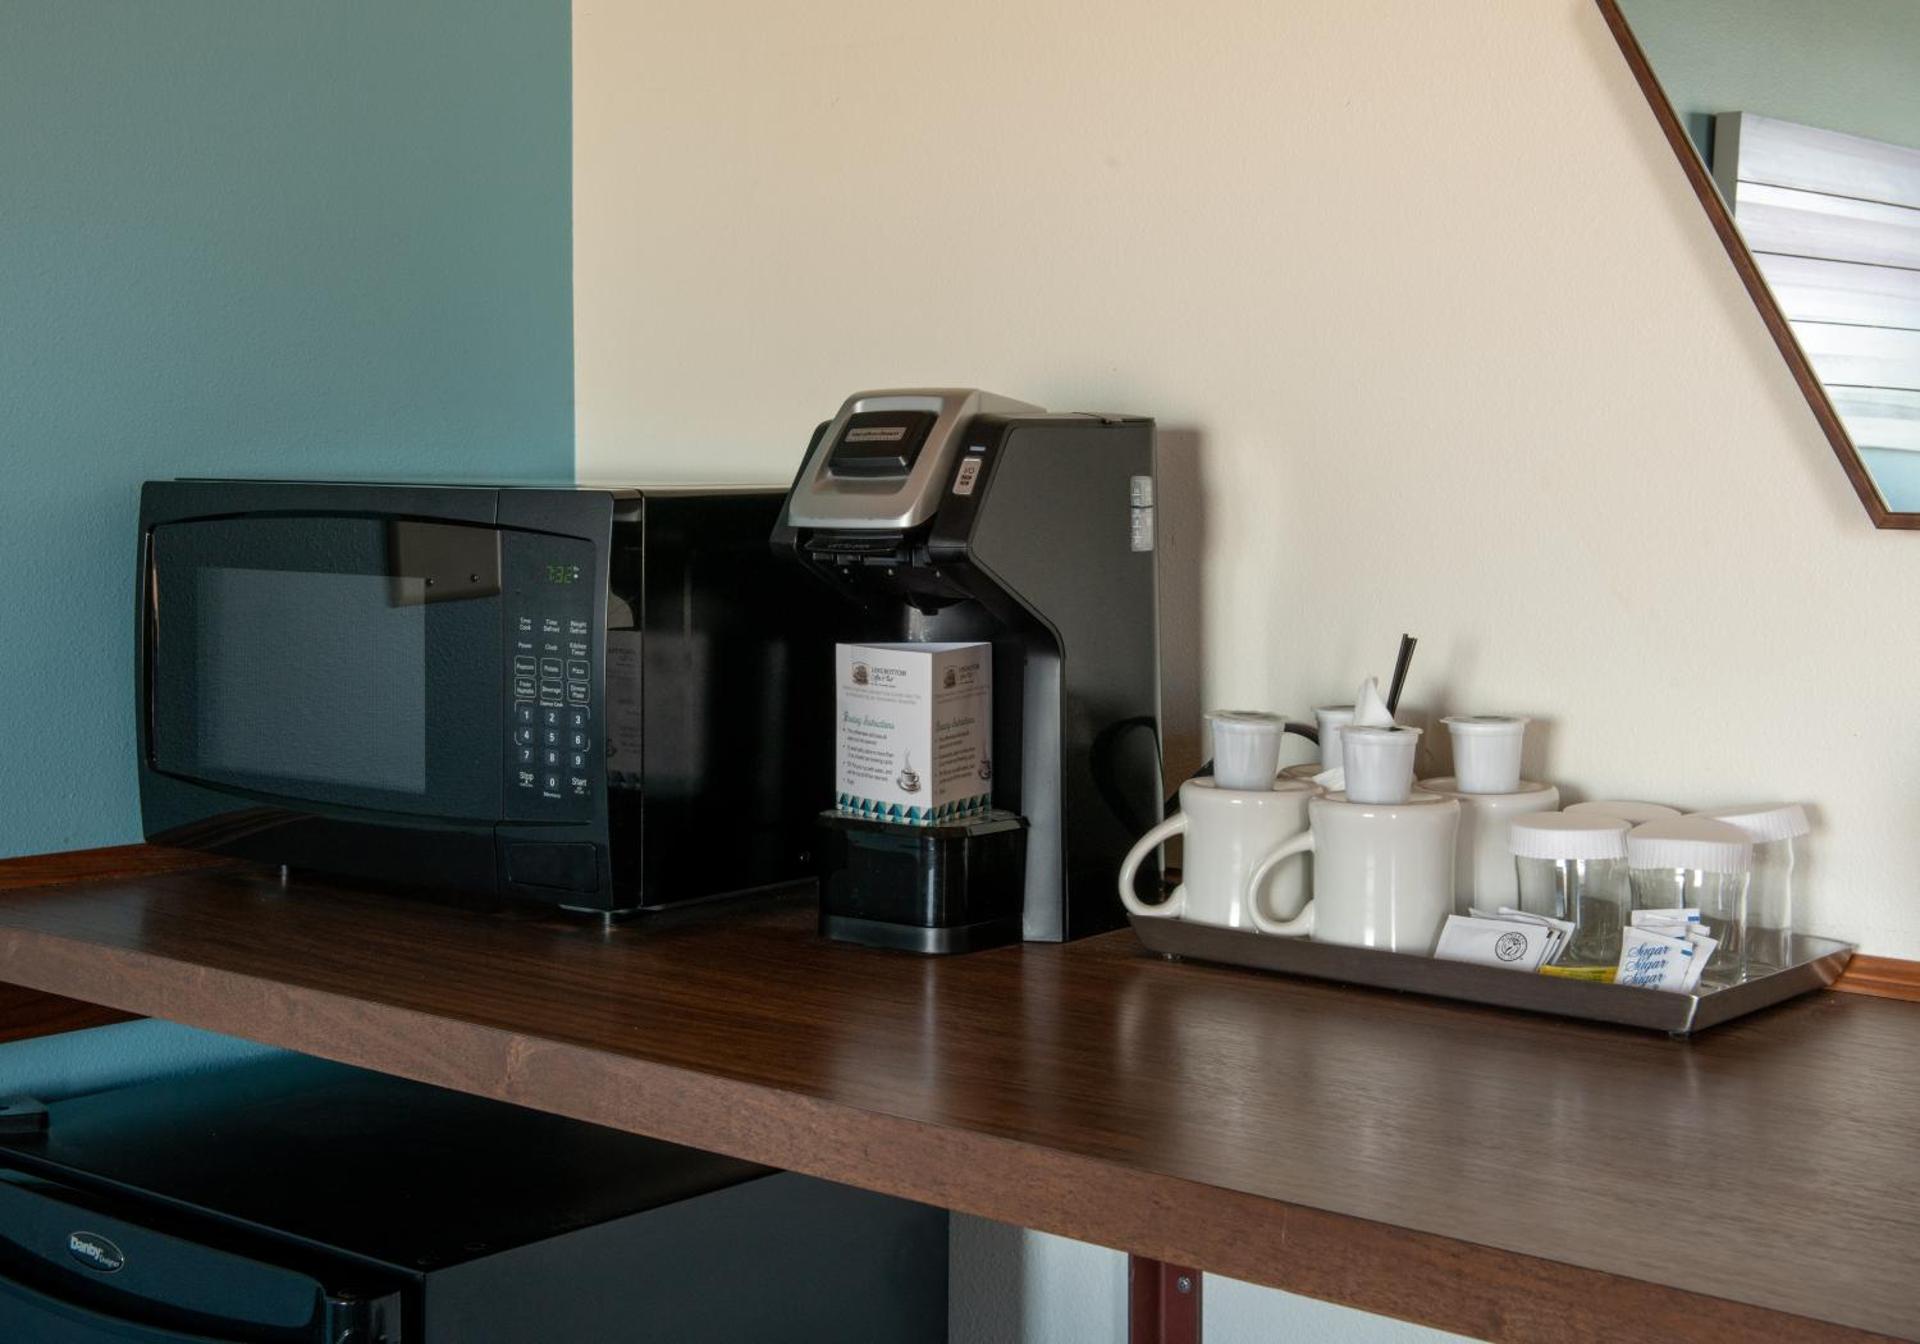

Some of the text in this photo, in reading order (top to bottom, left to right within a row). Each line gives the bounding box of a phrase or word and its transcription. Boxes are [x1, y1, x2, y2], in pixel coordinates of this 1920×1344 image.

[524, 710, 529, 720] 1
[548, 713, 555, 723] 2
[575, 715, 581, 724] 3
[524, 730, 530, 739] 4
[549, 732, 555, 742] 5
[575, 735, 581, 744] 6
[524, 750, 530, 759] 7
[549, 753, 555, 762] 8
[575, 756, 581, 765] 9
[549, 778, 555, 787] 0
[571, 777, 587, 787] Start
[1628, 942, 1671, 959] Sugar
[1625, 957, 1668, 973] Sugar
[1623, 972, 1664, 986] Sugar
